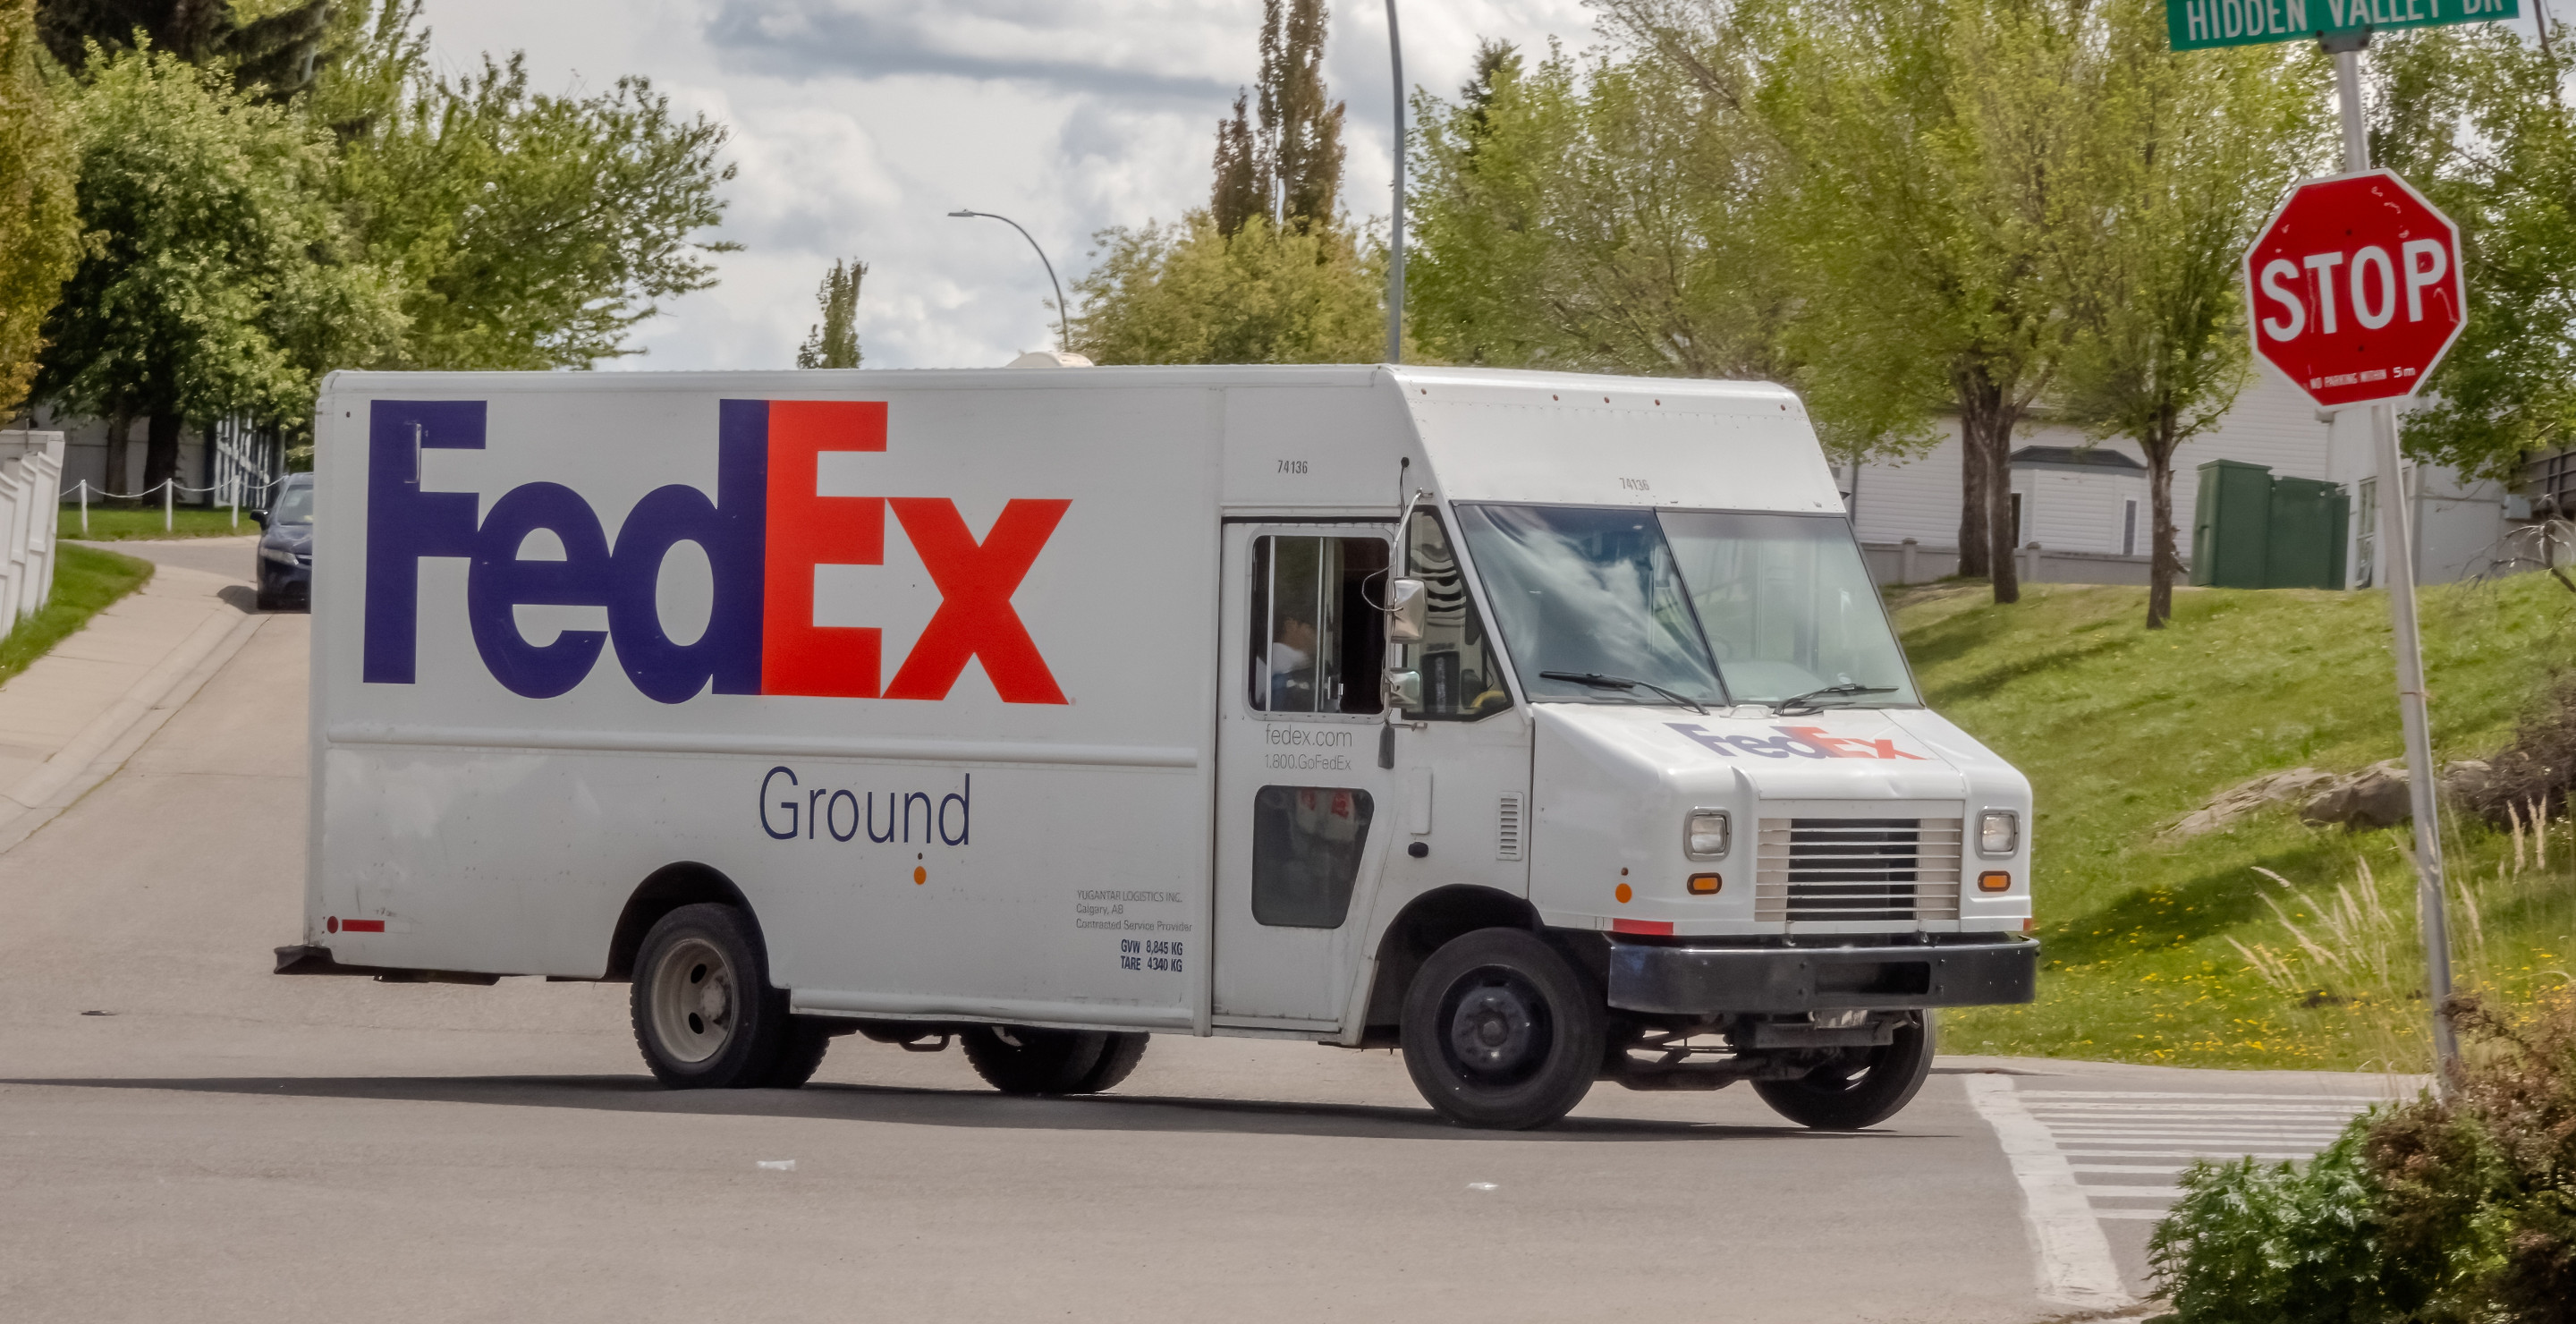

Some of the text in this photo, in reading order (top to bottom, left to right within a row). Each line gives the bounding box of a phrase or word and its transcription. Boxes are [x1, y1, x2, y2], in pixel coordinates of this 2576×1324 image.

[2186, 0, 2308, 41] HIDDEN
[2260, 238, 2447, 343] STOP
[2309, 377, 2322, 390] NO
[2324, 372, 2358, 388] PARKING
[2360, 369, 2387, 384] WITHIN
[1278, 460, 1309, 474] 74136
[1619, 477, 1650, 491] 74136
[363, 399, 1072, 705] FedEx
[1266, 723, 1353, 747] fedex.com
[1664, 722, 1928, 760] FedEx
[1265, 753, 1352, 770] 1.800.GoFedEx
[758, 767, 970, 846] Ground
[1077, 890, 1183, 903] YUGANTAR LOGISTICS INC.
[1076, 903, 1124, 916] Calgary, AB
[1076, 918, 1192, 931] Contracted Service Provider
[1121, 938, 1183, 956] GVW 8,845 KG
[1120, 955, 1182, 972] TARE 4340 KG
